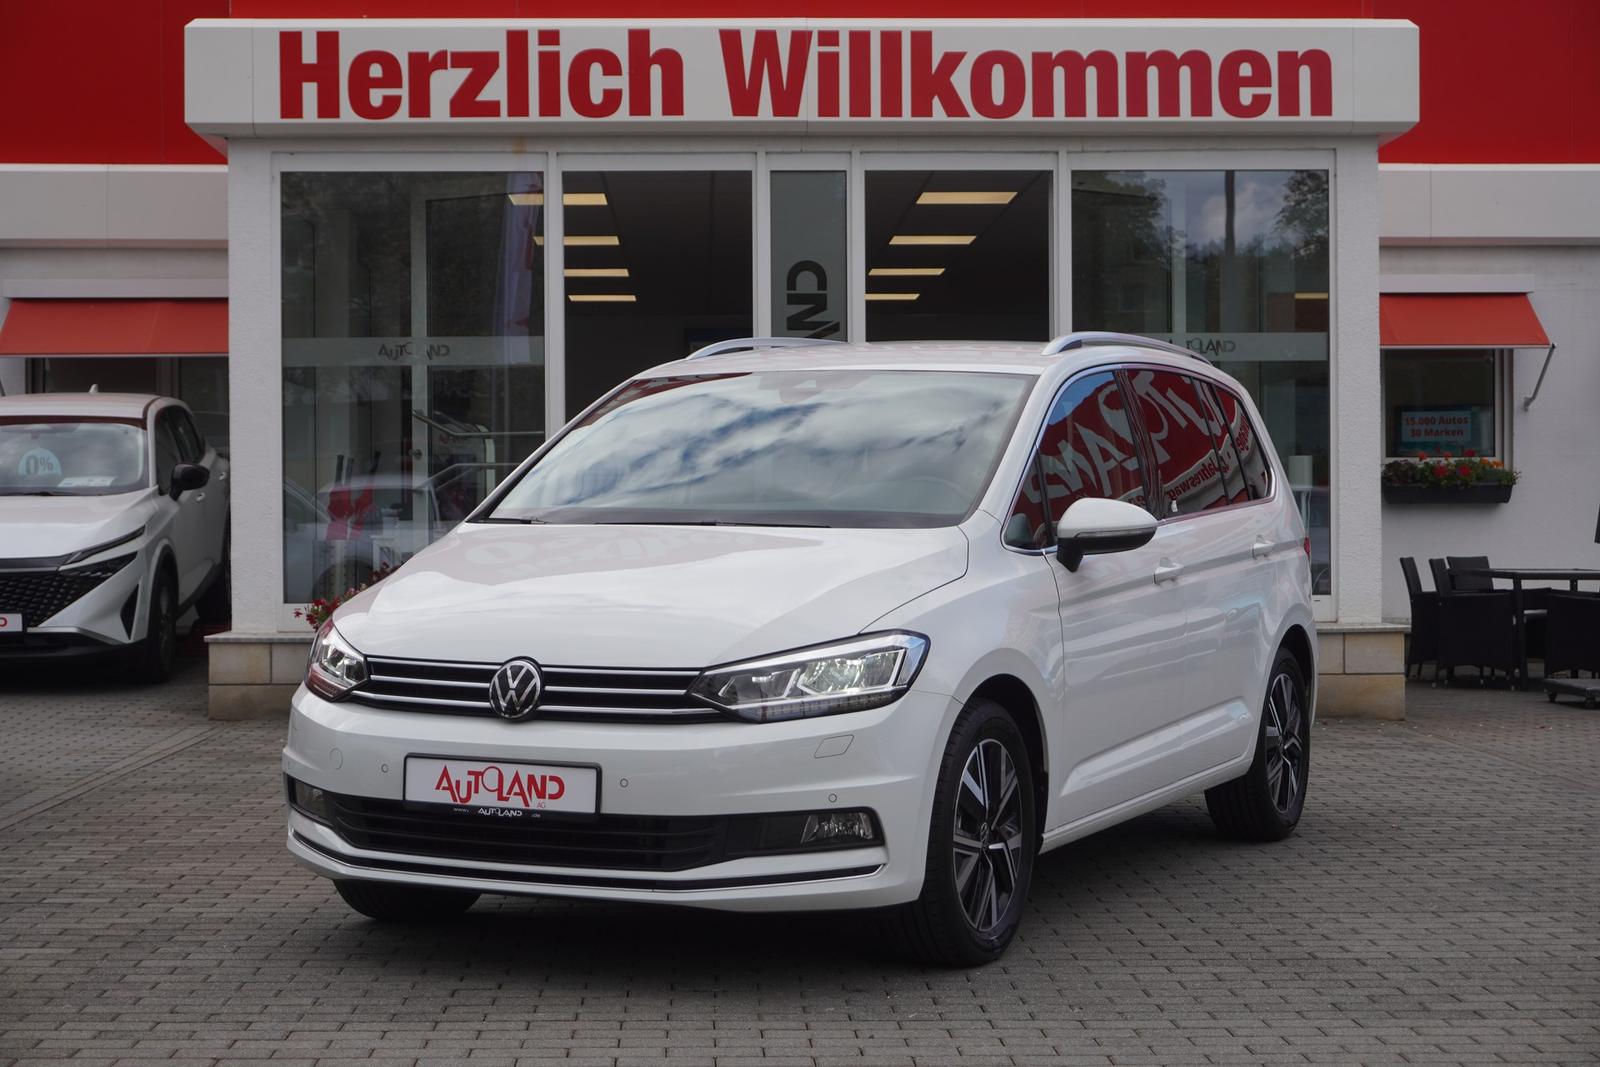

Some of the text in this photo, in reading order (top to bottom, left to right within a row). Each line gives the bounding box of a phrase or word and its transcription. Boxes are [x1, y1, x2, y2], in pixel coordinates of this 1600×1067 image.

[279, 29, 1333, 120] Herzlich Willkommen
[1439, 415, 1469, 425] Autos
[1409, 427, 1464, 438] 30 Marken
[25, 455, 54, 476] 0%
